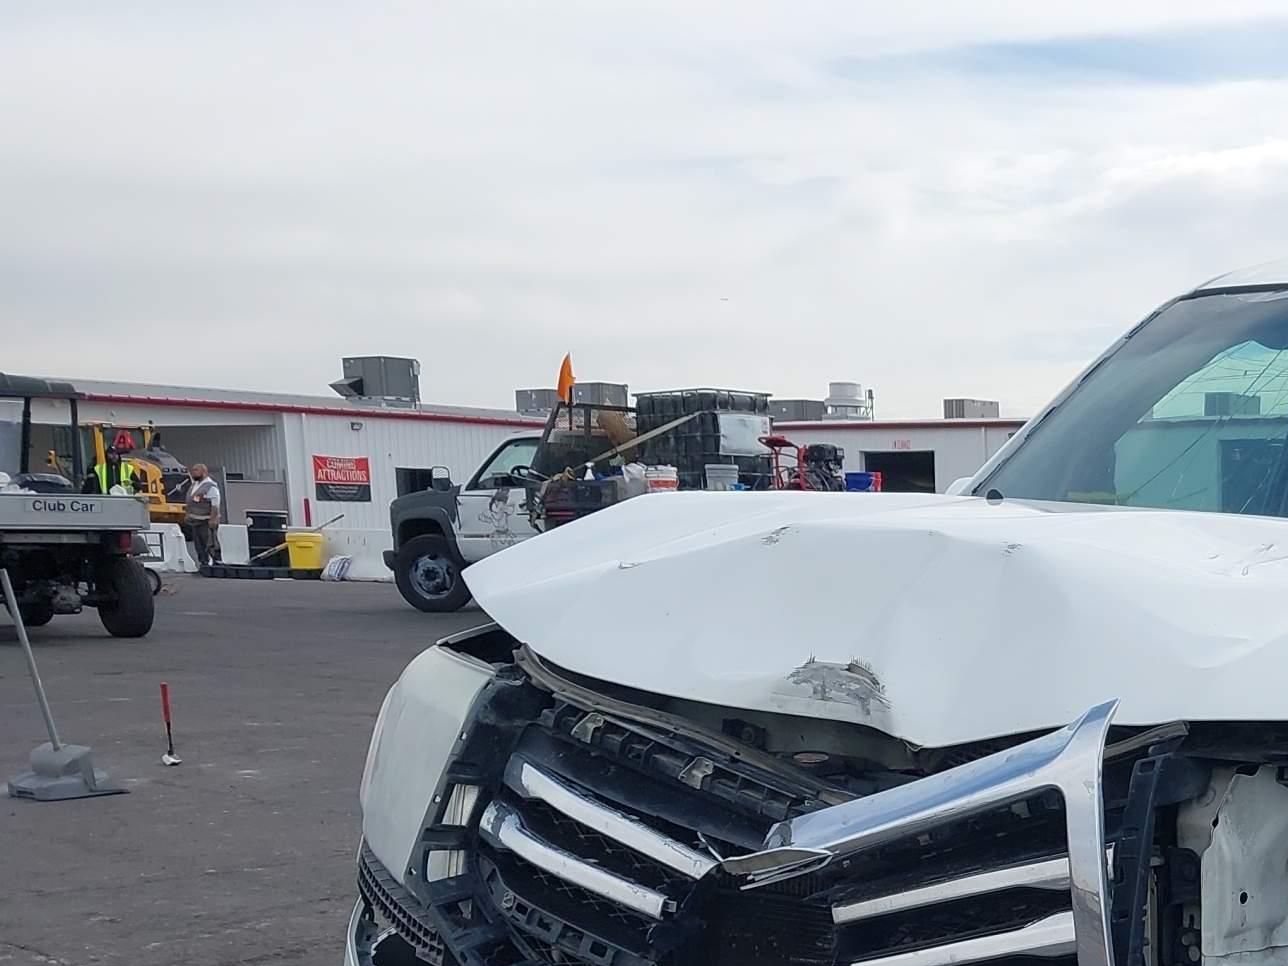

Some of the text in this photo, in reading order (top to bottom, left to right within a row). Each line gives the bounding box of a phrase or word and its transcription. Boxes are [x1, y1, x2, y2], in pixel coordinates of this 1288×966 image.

[317, 469, 367, 481] ATTRACTIONS
[32, 499, 95, 512] Club Car
